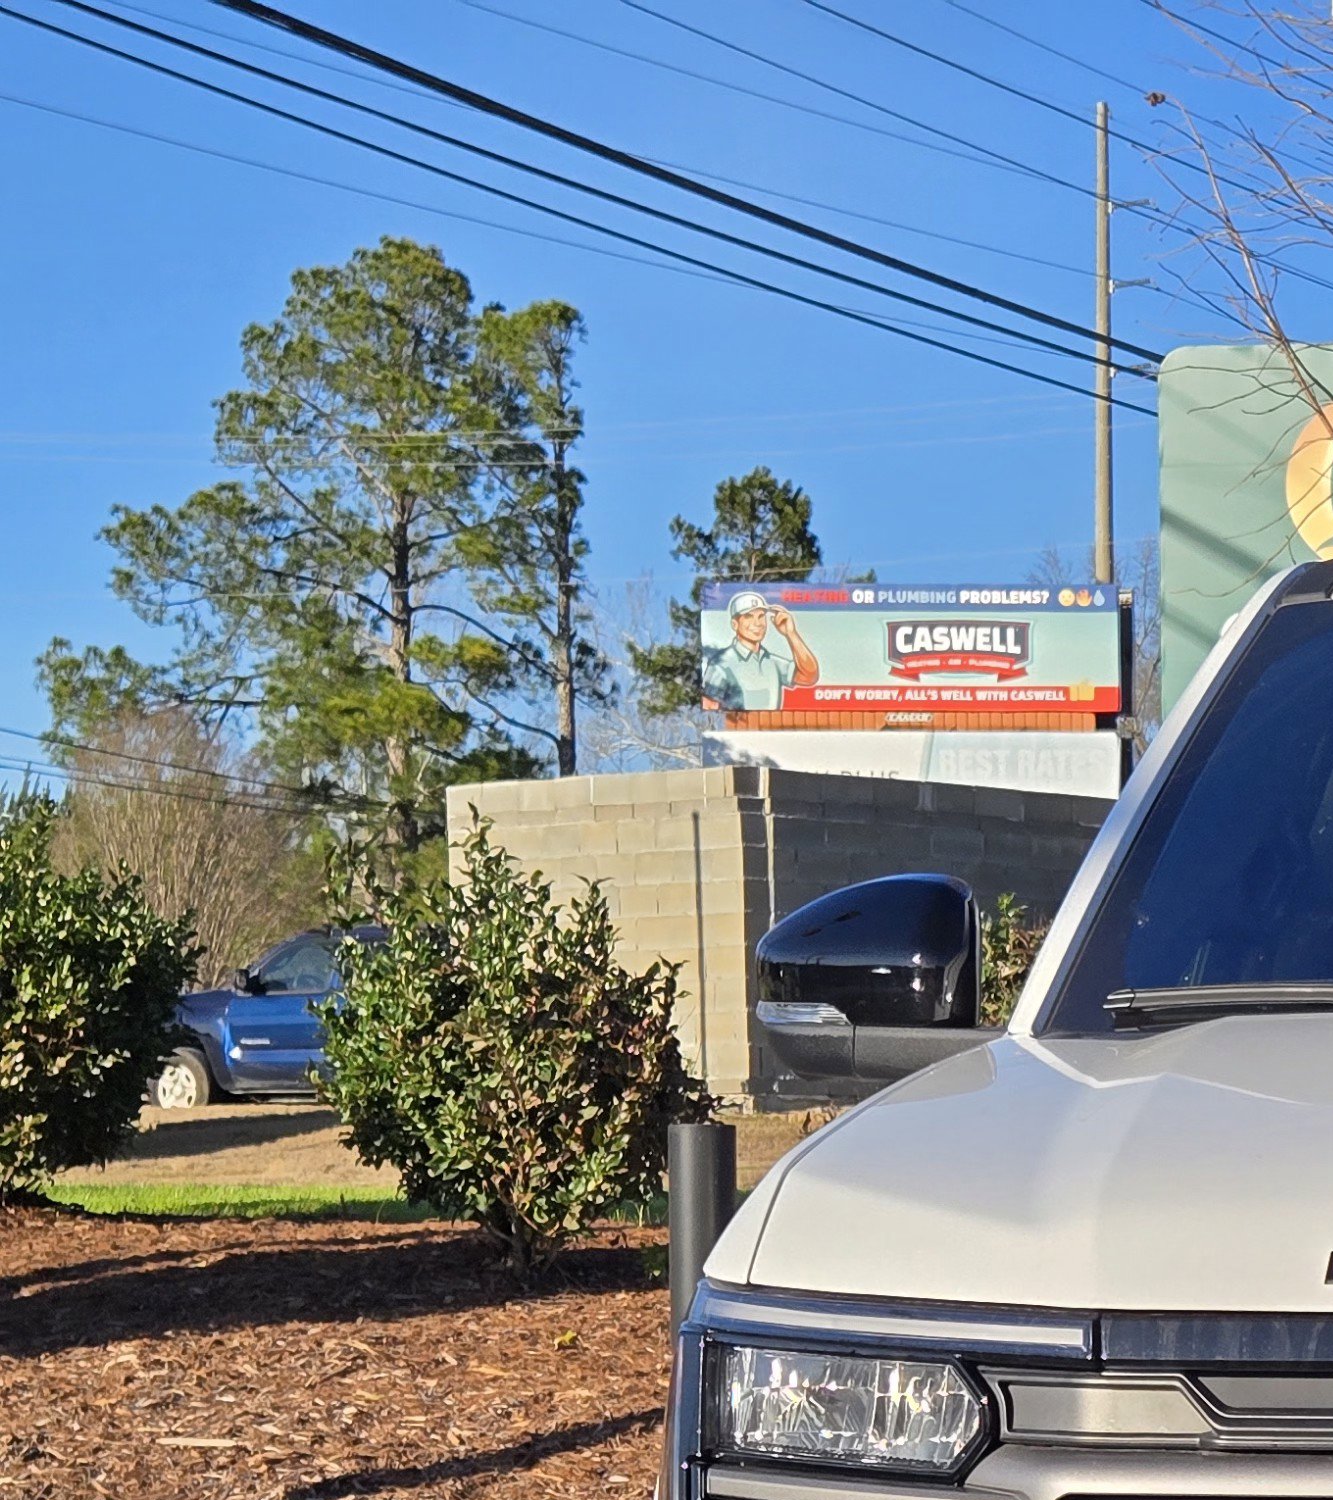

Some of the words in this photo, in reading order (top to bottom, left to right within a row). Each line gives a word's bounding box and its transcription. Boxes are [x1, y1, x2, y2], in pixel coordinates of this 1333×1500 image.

[852, 589, 874, 604] OR
[878, 590, 956, 604] PLUMBING
[959, 590, 1049, 605] PROBLEMS?
[896, 626, 1021, 654] CASWELL
[814, 689, 851, 701] DON'T
[855, 689, 902, 702] WORRY,
[905, 689, 938, 701] ALL'S
[941, 690, 973, 701] WELL
[975, 690, 1008, 701] WITH
[1010, 690, 1066, 701] CASWELL
